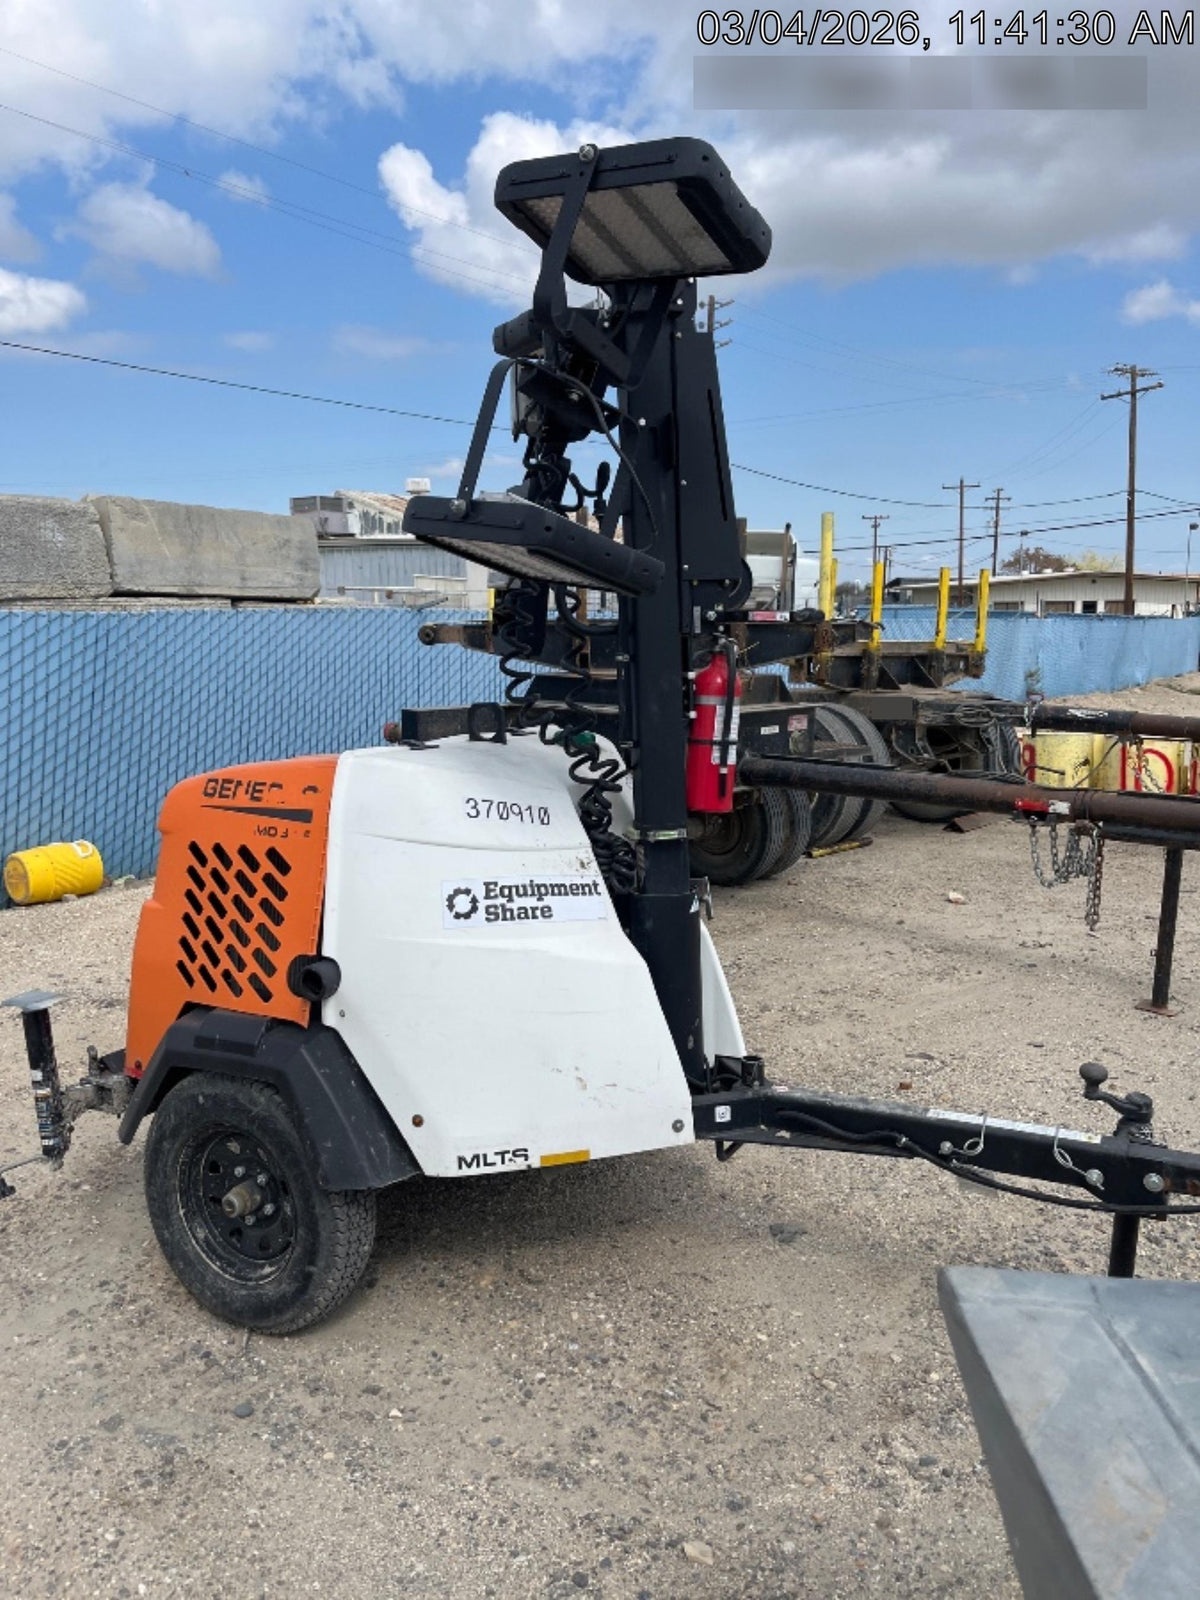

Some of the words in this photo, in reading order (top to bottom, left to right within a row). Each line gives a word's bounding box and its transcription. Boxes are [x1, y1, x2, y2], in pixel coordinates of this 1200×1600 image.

[465, 797, 550, 826] 370910
[483, 879, 602, 903] Equipment
[484, 902, 554, 923] Share
